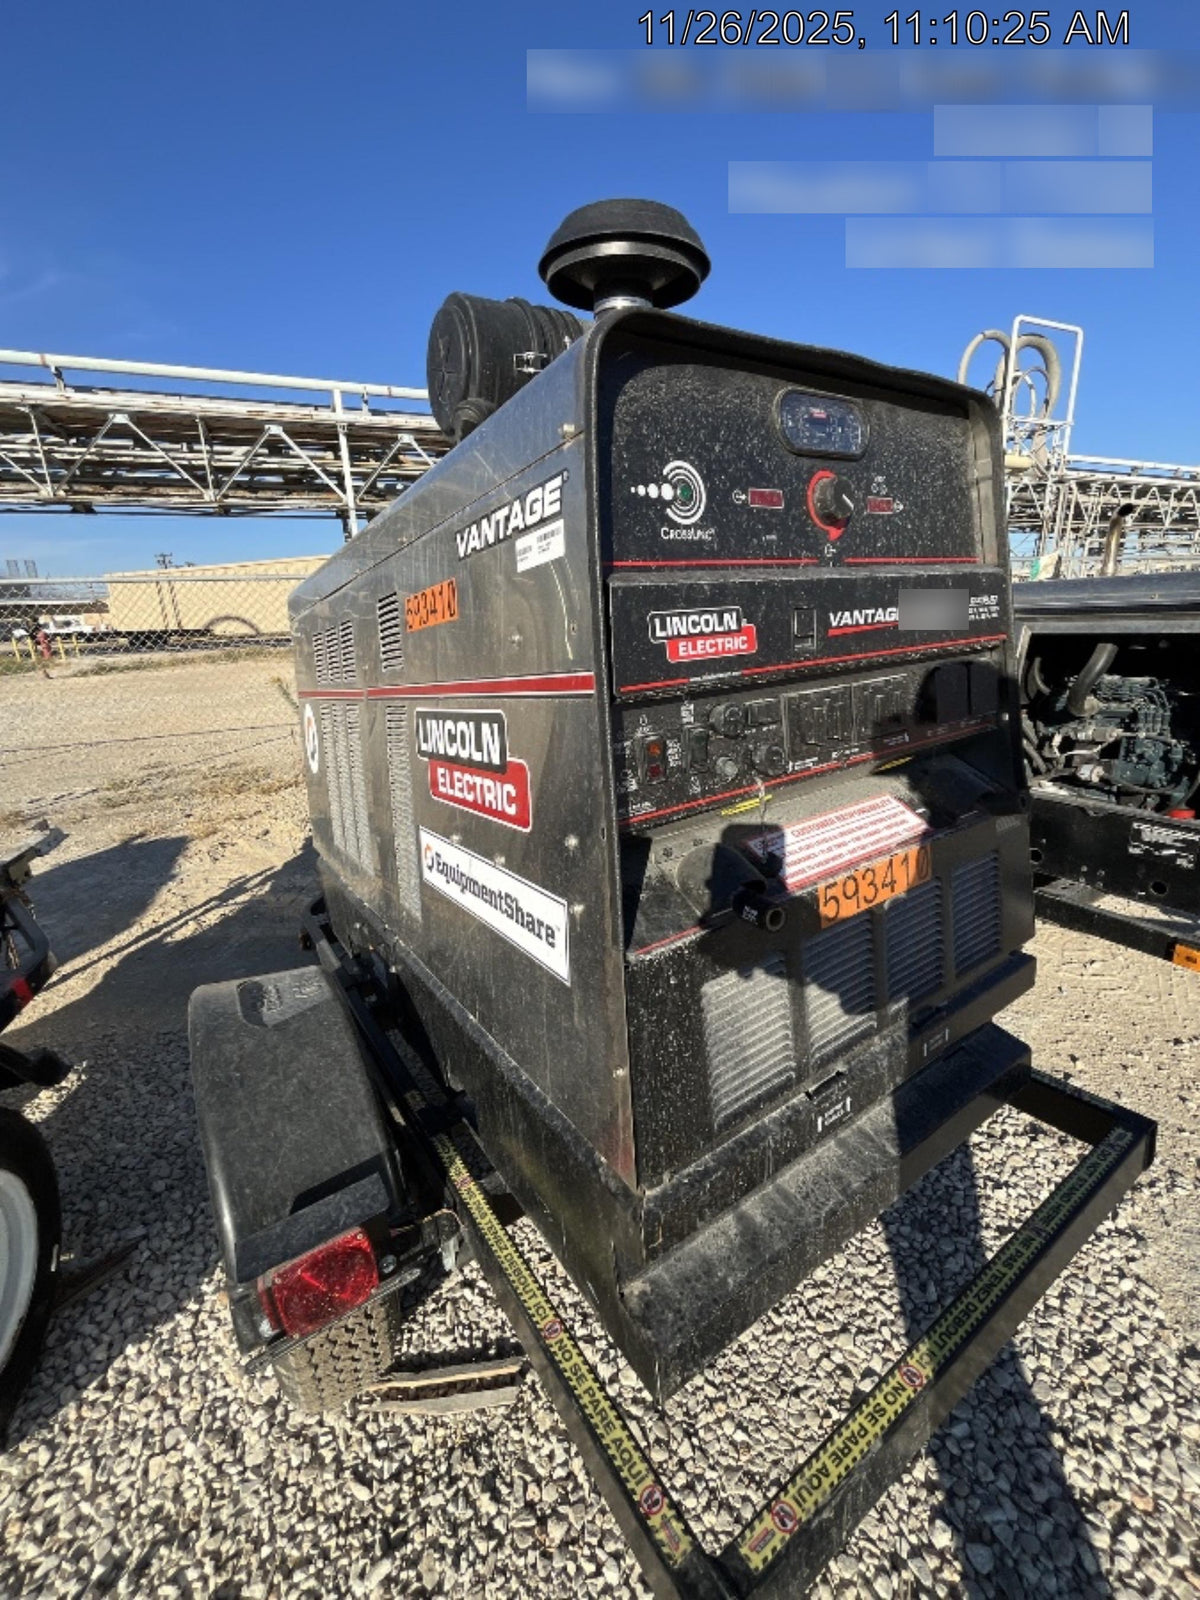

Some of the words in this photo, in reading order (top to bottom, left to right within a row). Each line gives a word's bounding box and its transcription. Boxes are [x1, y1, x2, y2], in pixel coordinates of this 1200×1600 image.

[456, 478, 563, 558] VANTAGE
[653, 609, 738, 637] LINCOLN
[829, 606, 899, 627] VANTAG
[678, 634, 748, 657] ELECTRIC
[418, 717, 501, 764] LINCOLN
[436, 767, 517, 815] ELECTRIC
[434, 852, 557, 948] EquipmentShare
[822, 846, 930, 922] 593410
[1002, 1249, 1024, 1271] PAS
[505, 1254, 537, 1301] DEBOUT
[533, 1302, 548, 1320] ICI
[977, 1269, 1007, 1302] TENEZ
[937, 1302, 978, 1349] DEBOUT
[915, 1348, 936, 1370] ICI
[554, 1338, 573, 1361] NO
[570, 1363, 588, 1386] SE
[584, 1387, 616, 1435] PARE
[883, 1380, 906, 1406] NO
[864, 1402, 887, 1427] SE
[830, 1422, 869, 1466] PARE
